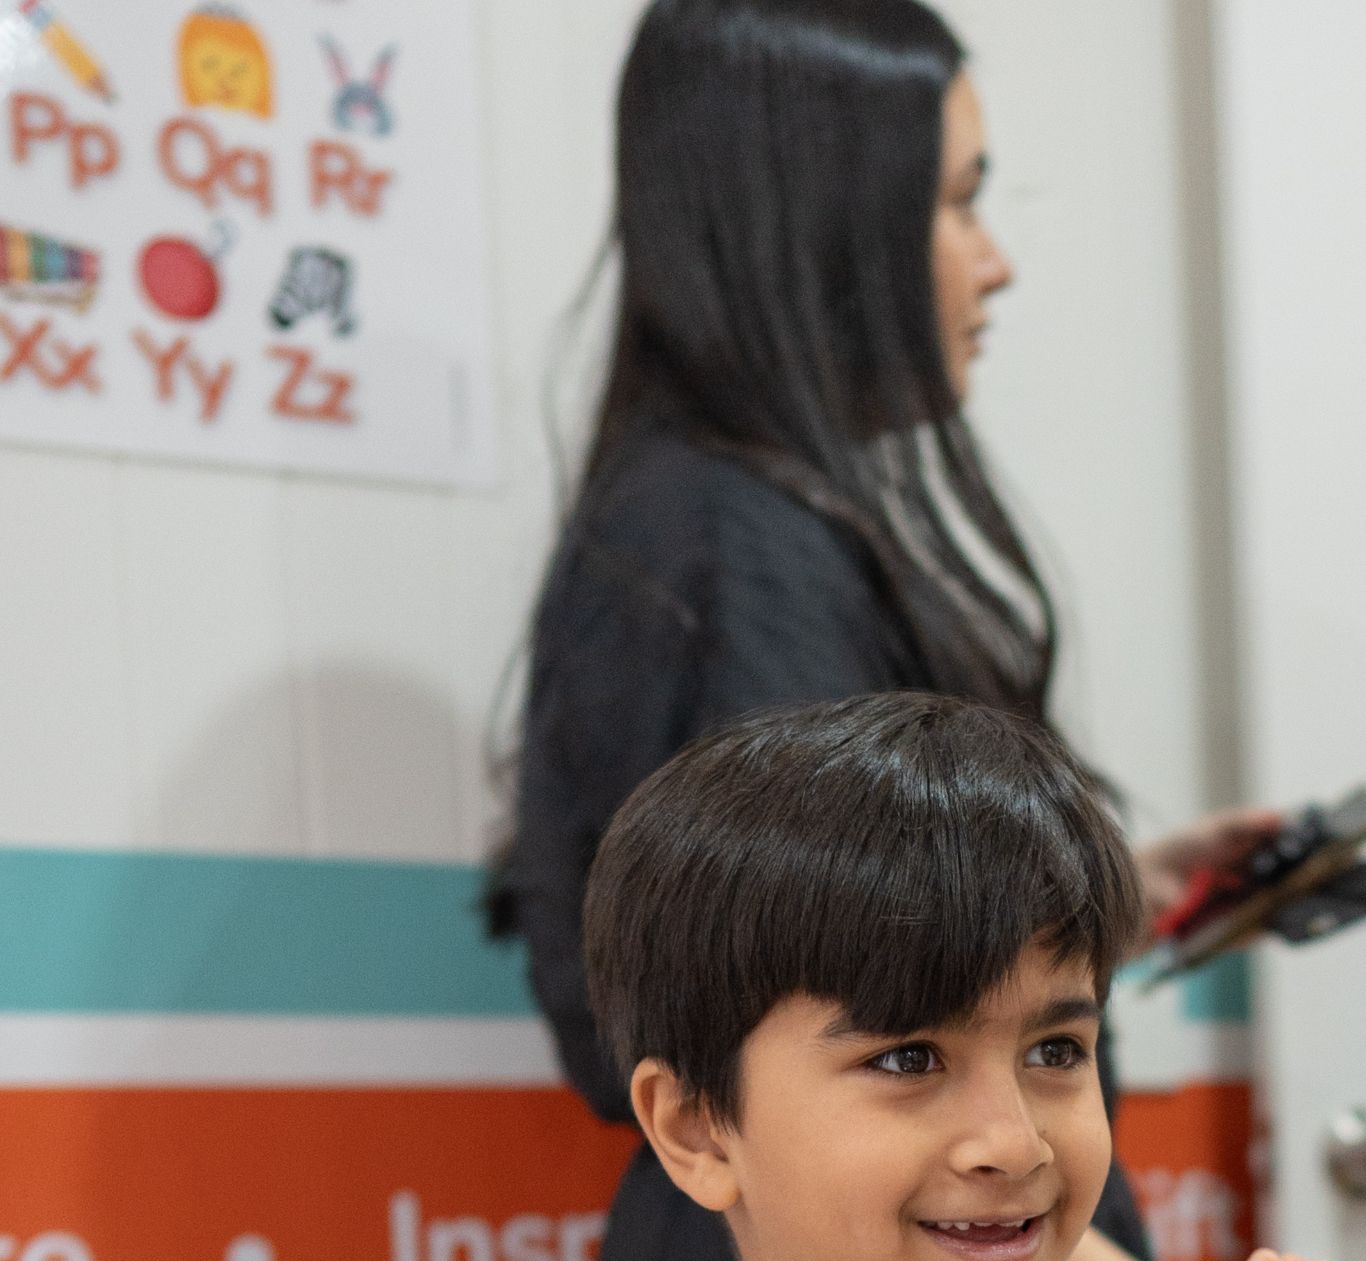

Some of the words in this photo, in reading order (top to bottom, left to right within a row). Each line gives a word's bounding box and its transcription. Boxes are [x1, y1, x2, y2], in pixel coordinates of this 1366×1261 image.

[8, 92, 121, 190] Pp
[155, 115, 275, 217] Qq
[307, 138, 391, 216] Rr
[0, 311, 102, 395] Xx
[130, 326, 235, 423] Yy
[264, 342, 357, 424] Zz
